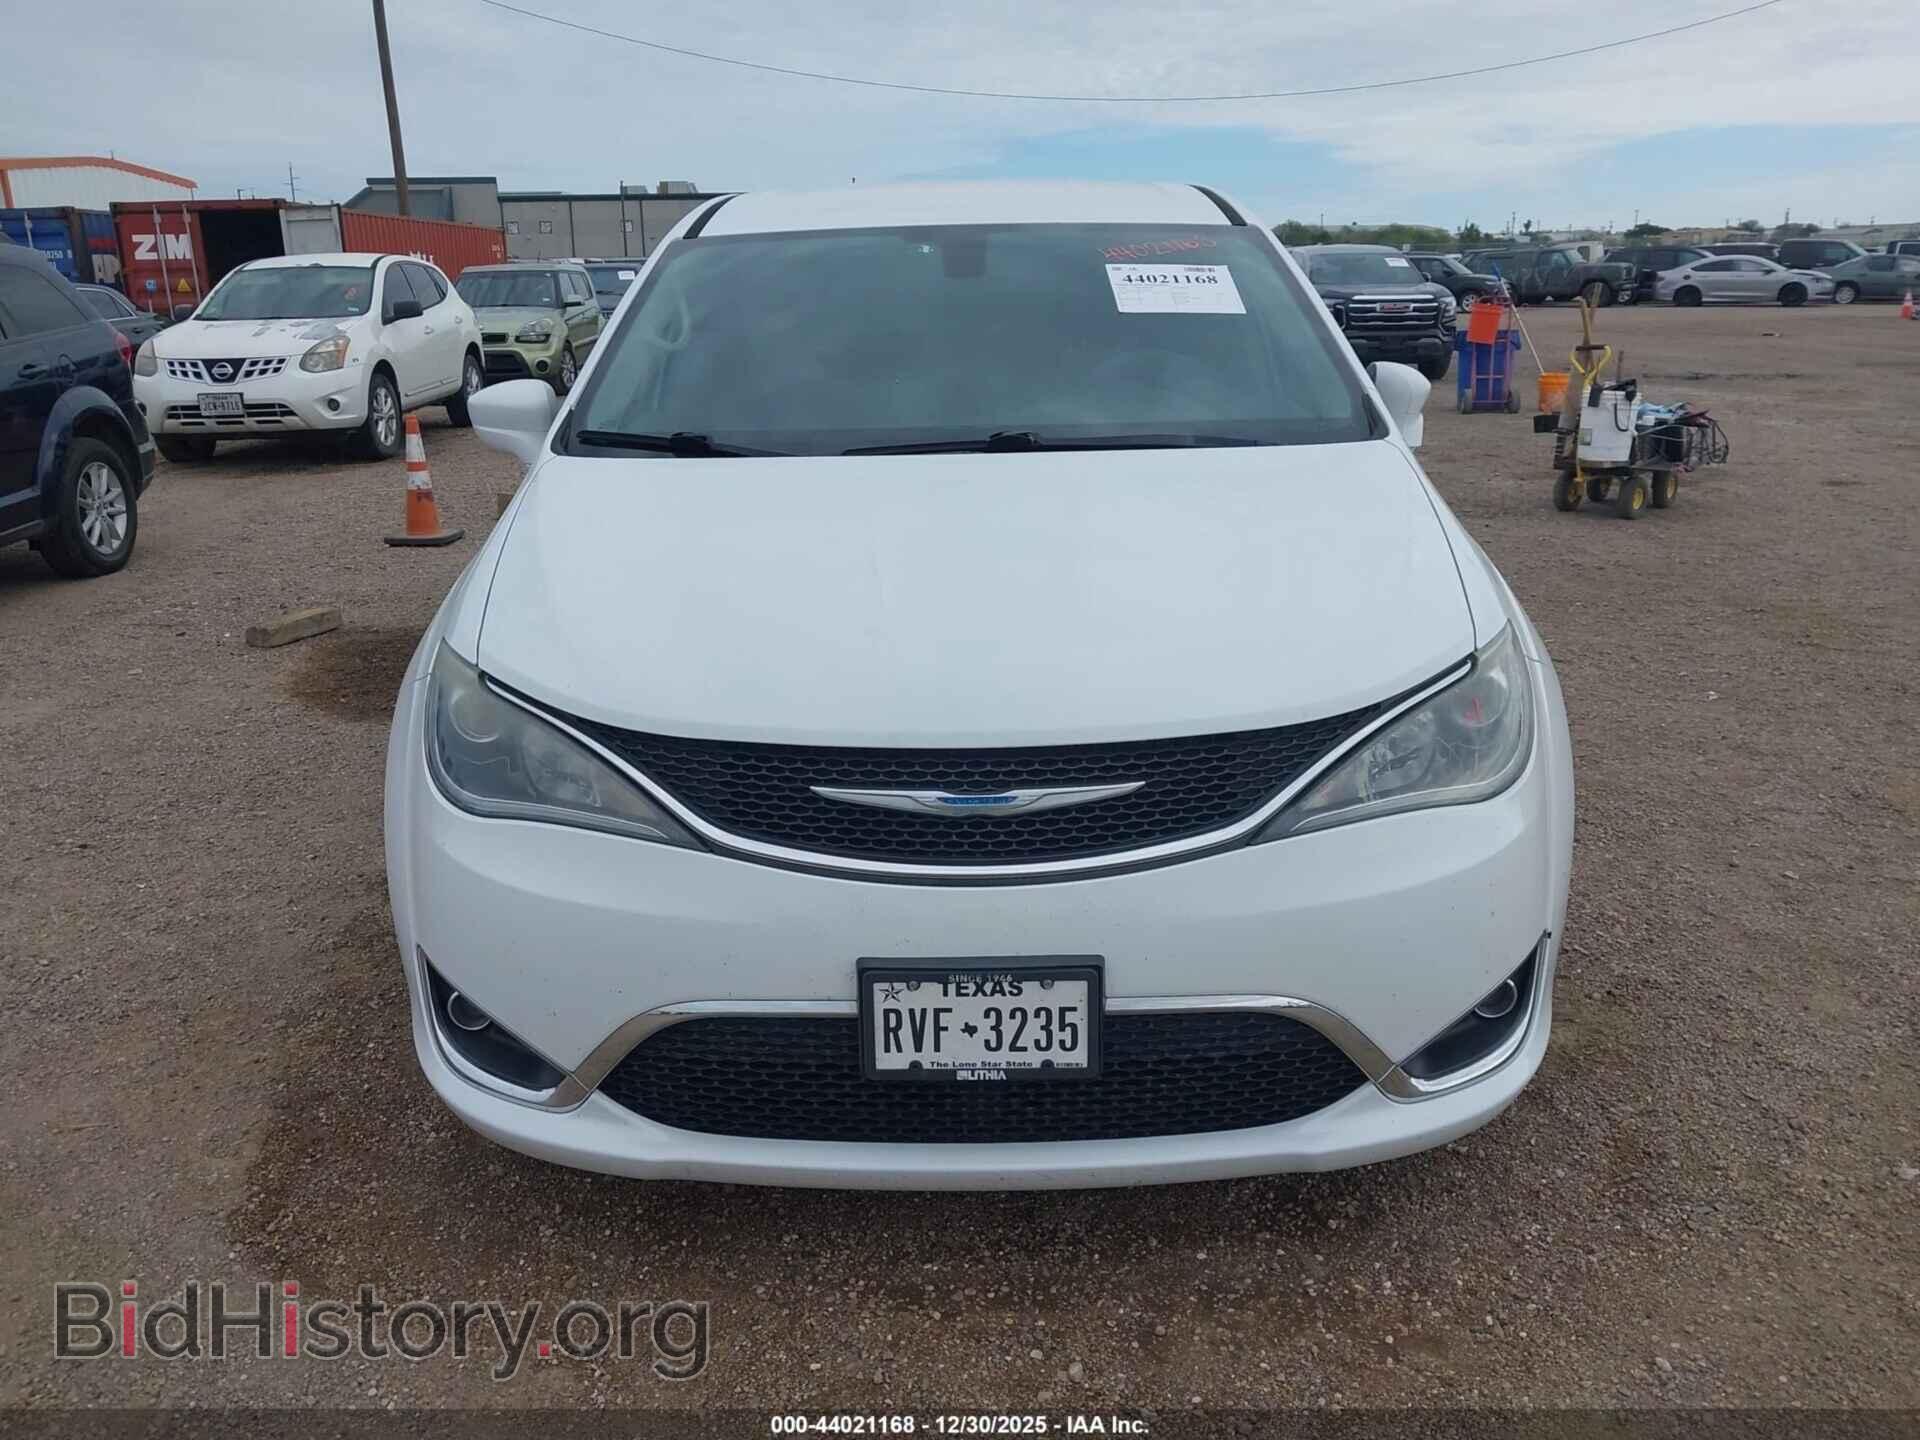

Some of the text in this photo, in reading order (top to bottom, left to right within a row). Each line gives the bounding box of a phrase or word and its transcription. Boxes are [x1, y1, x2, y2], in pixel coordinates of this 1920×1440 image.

[131, 233, 193, 261] ZIM
[1122, 273, 1218, 285] 44021168
[942, 977, 1023, 997] TEXAS
[882, 1006, 1079, 1053] RVF 3235
